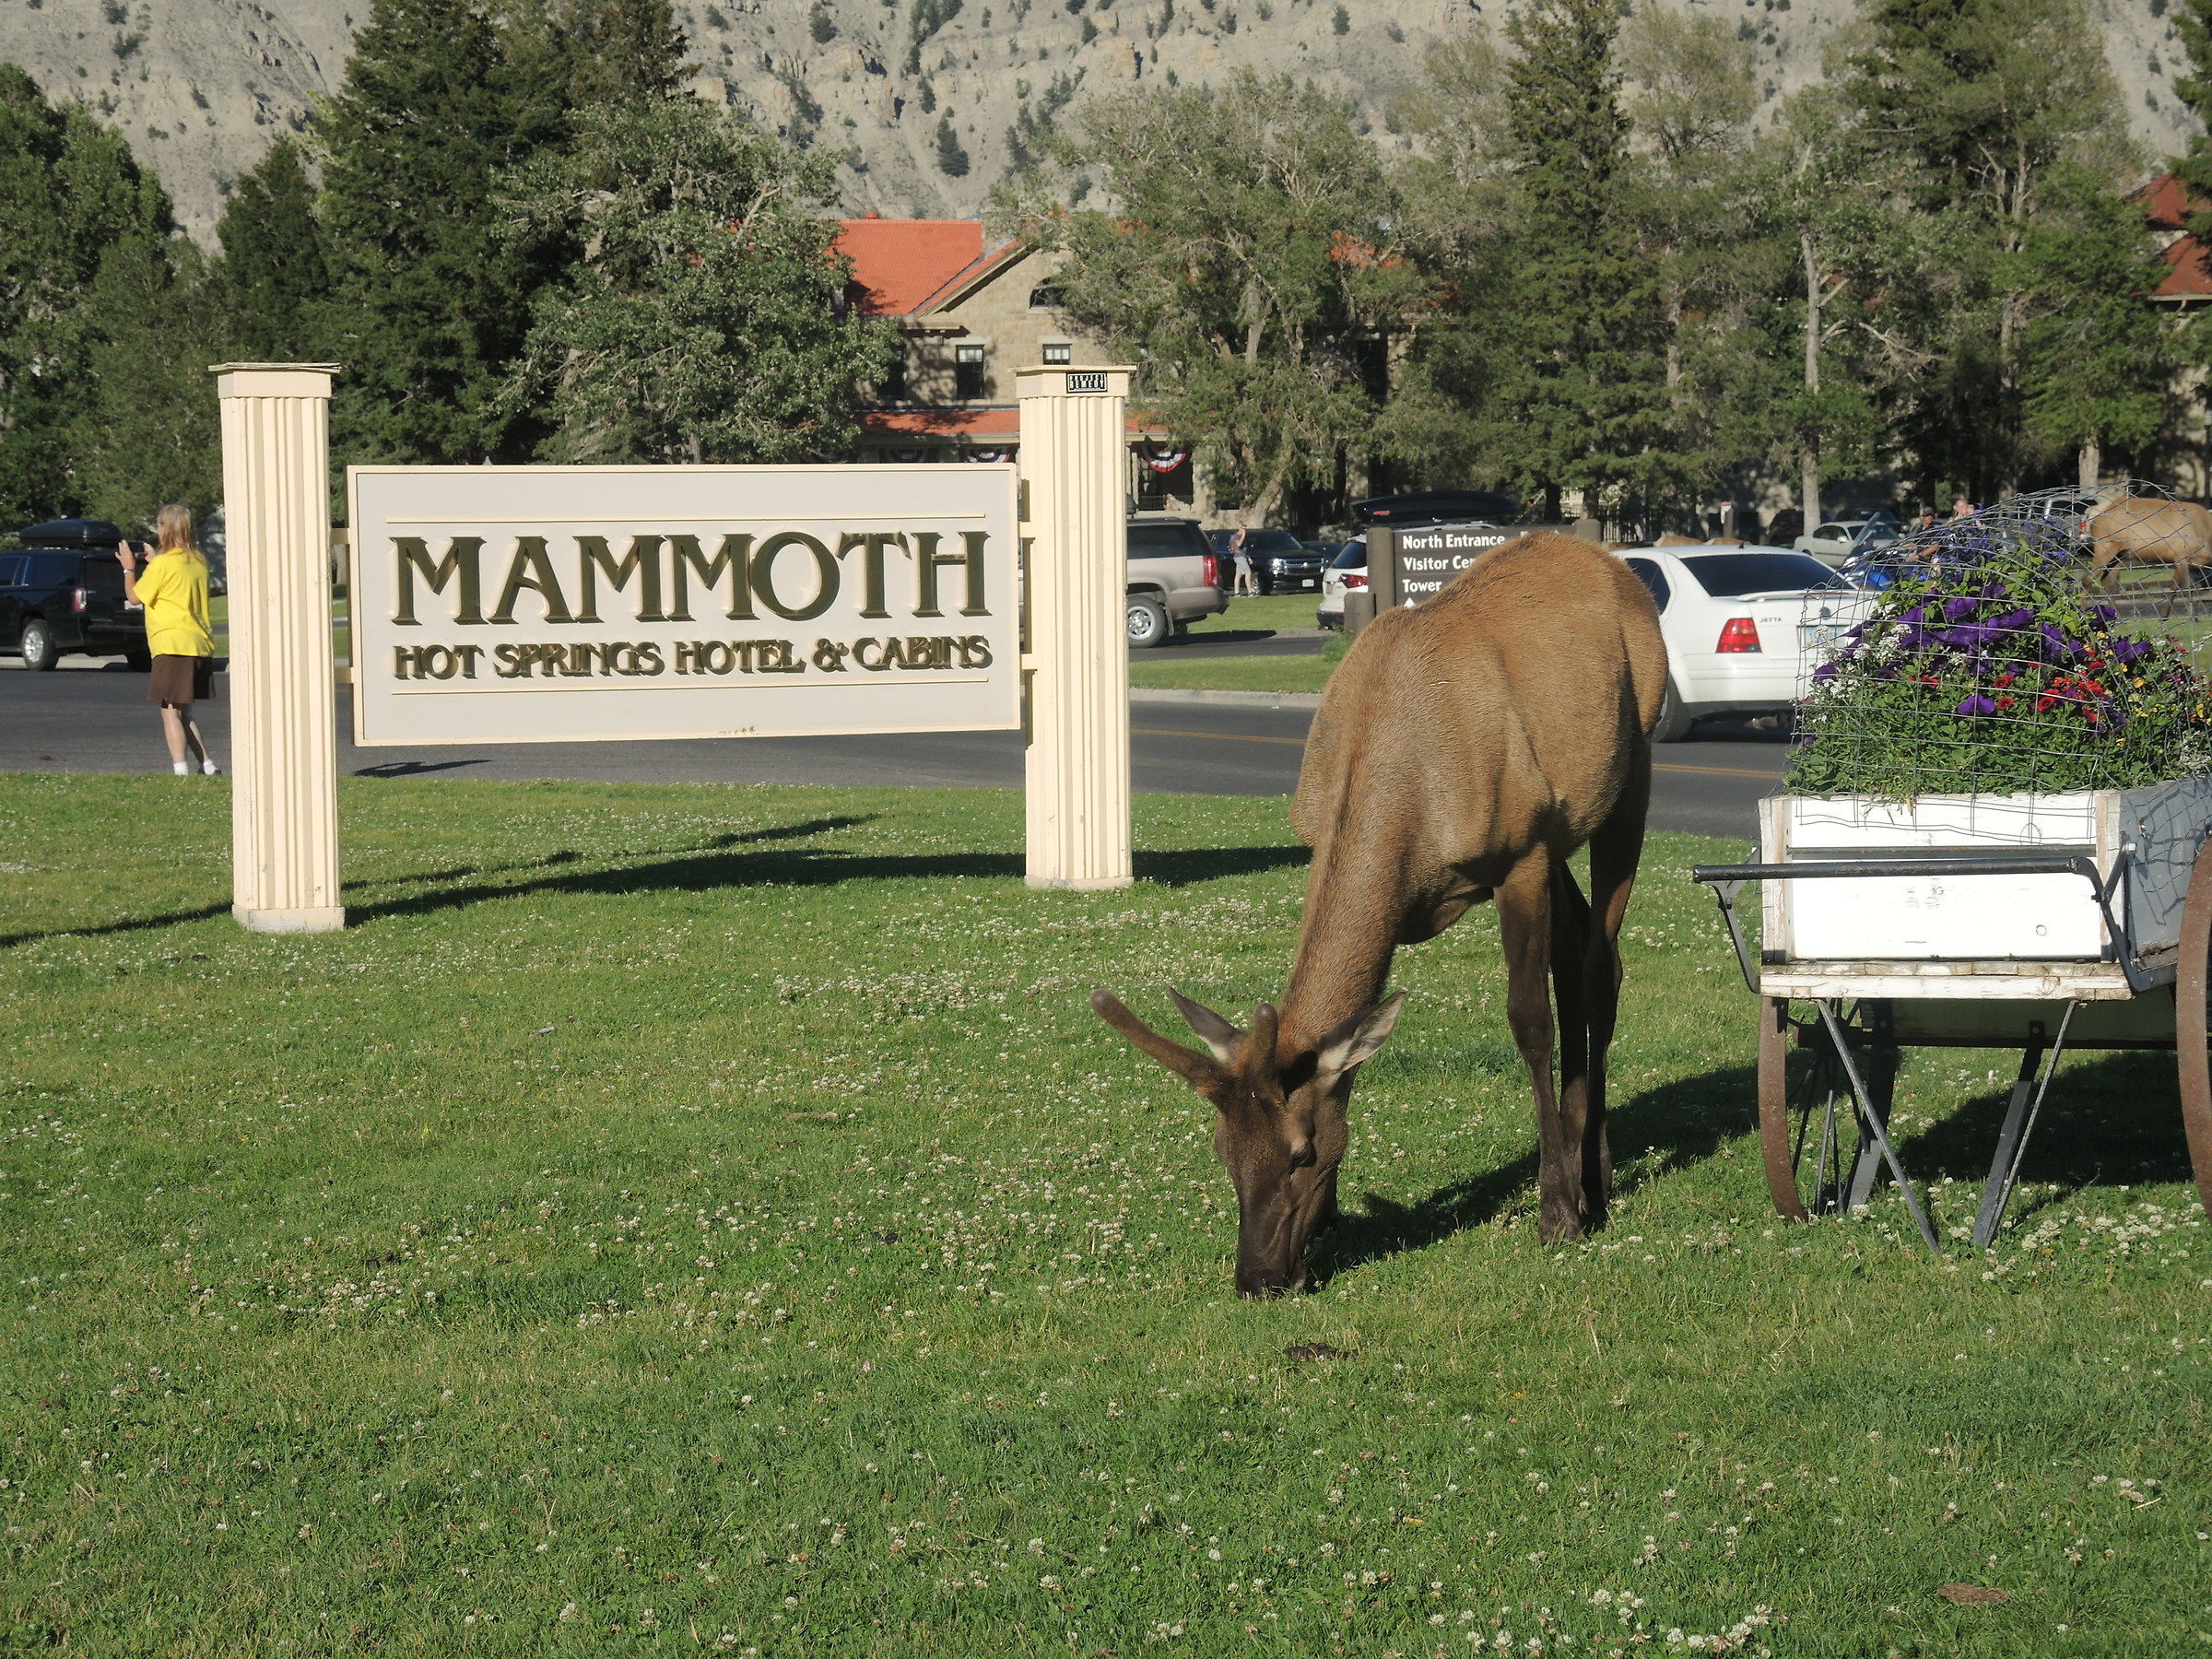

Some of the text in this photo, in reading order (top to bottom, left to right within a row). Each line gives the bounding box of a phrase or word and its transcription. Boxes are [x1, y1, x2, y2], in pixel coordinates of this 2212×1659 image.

[1403, 534, 1505, 549] North Entrance
[1403, 557, 1449, 571] Visitor
[389, 532, 993, 625] MAMMOTH
[1402, 579, 1442, 593] Tower
[393, 635, 994, 680] HOT SPRINGS HOTEL & CABINS
